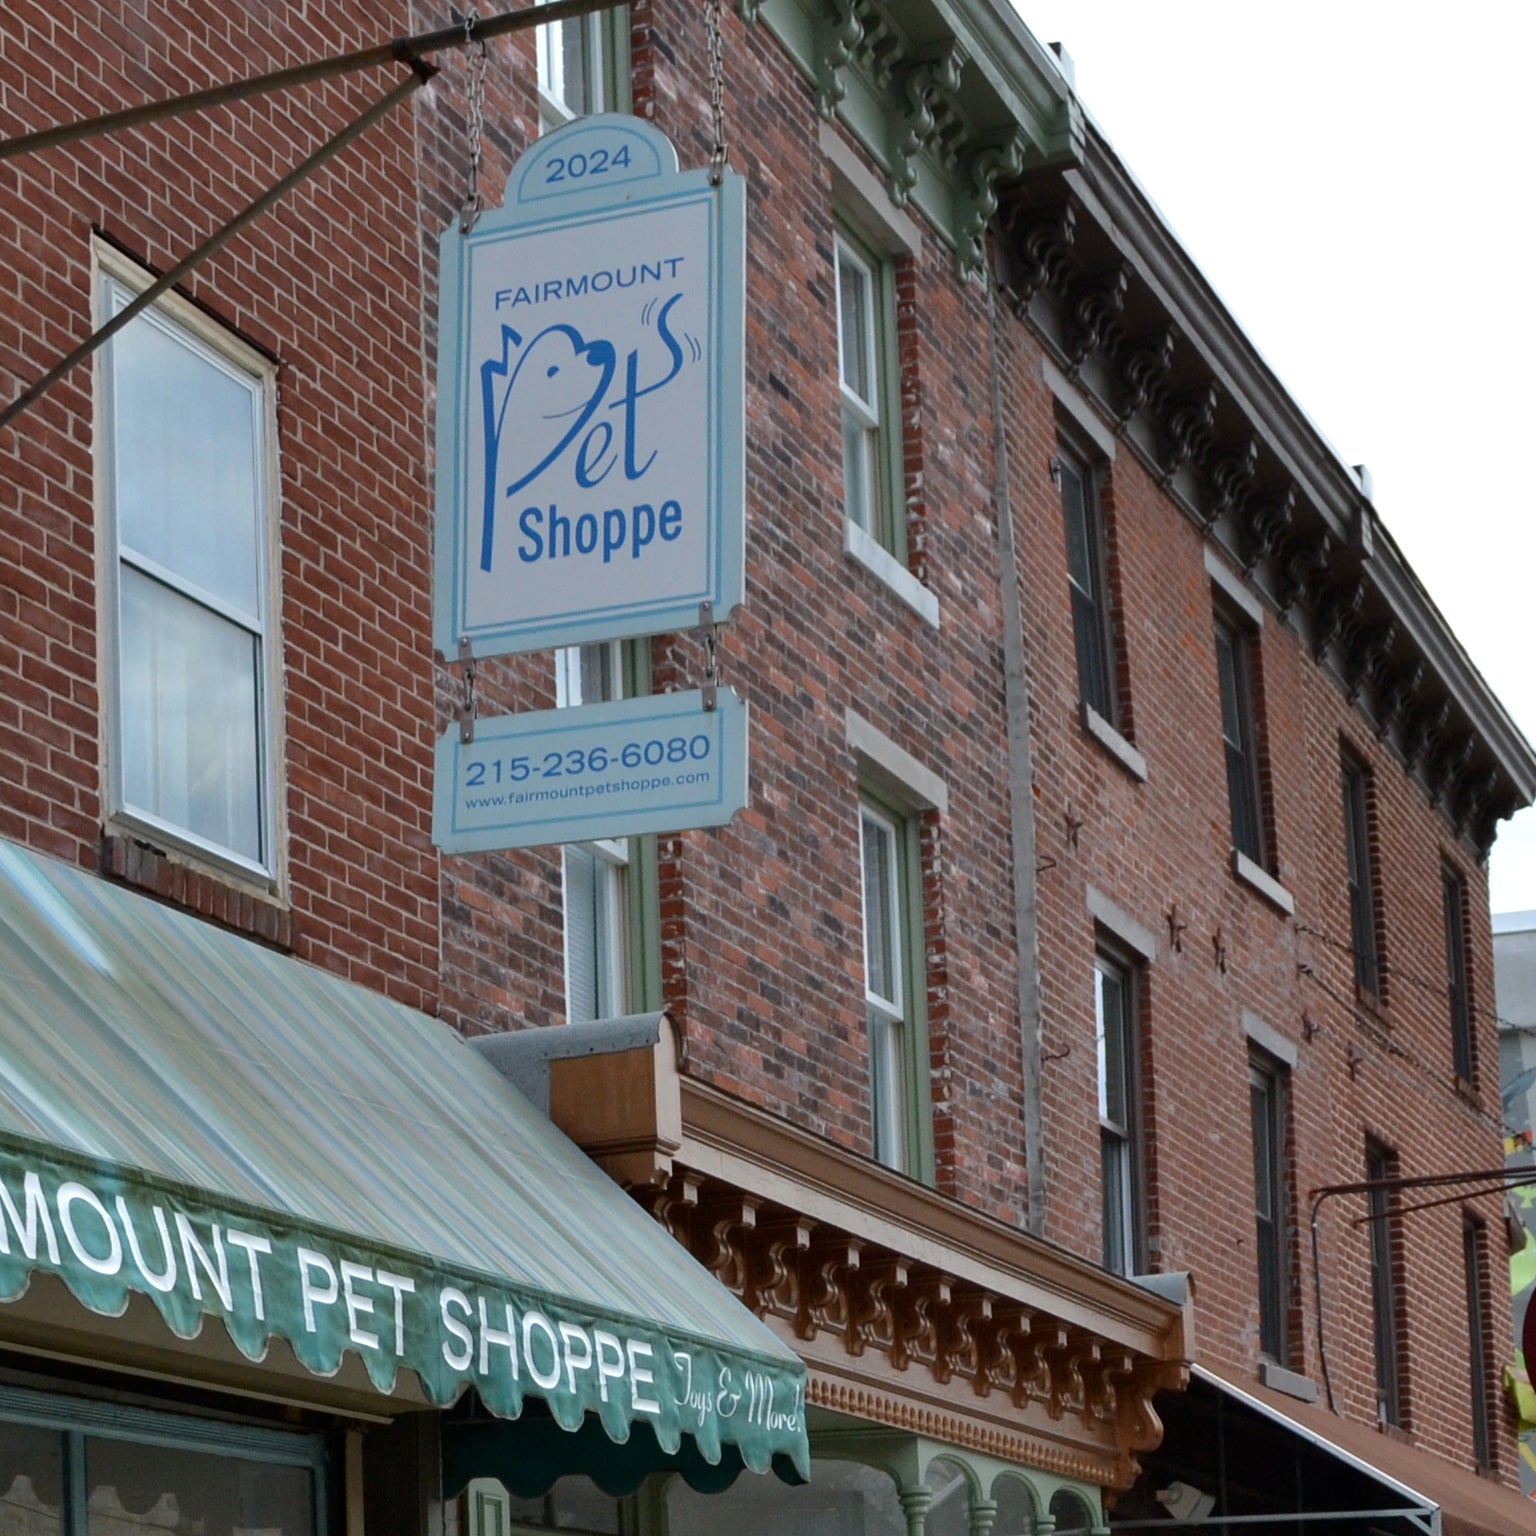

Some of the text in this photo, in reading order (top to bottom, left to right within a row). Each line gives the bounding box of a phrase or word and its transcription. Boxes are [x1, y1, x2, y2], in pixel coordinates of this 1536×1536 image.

[545, 144, 632, 184] 2024
[493, 257, 685, 312] FAIRMOUNT
[517, 498, 683, 564] Shoppe
[465, 733, 711, 788] 215-236-6080
[464, 768, 711, 811] www.fairmountpetshoppe.com
[297, 1249, 417, 1357] PET
[439, 1286, 661, 1415] SHOPPE
[673, 1352, 713, 1428] Toys
[716, 1366, 742, 1418] &
[745, 1370, 801, 1433] More!
